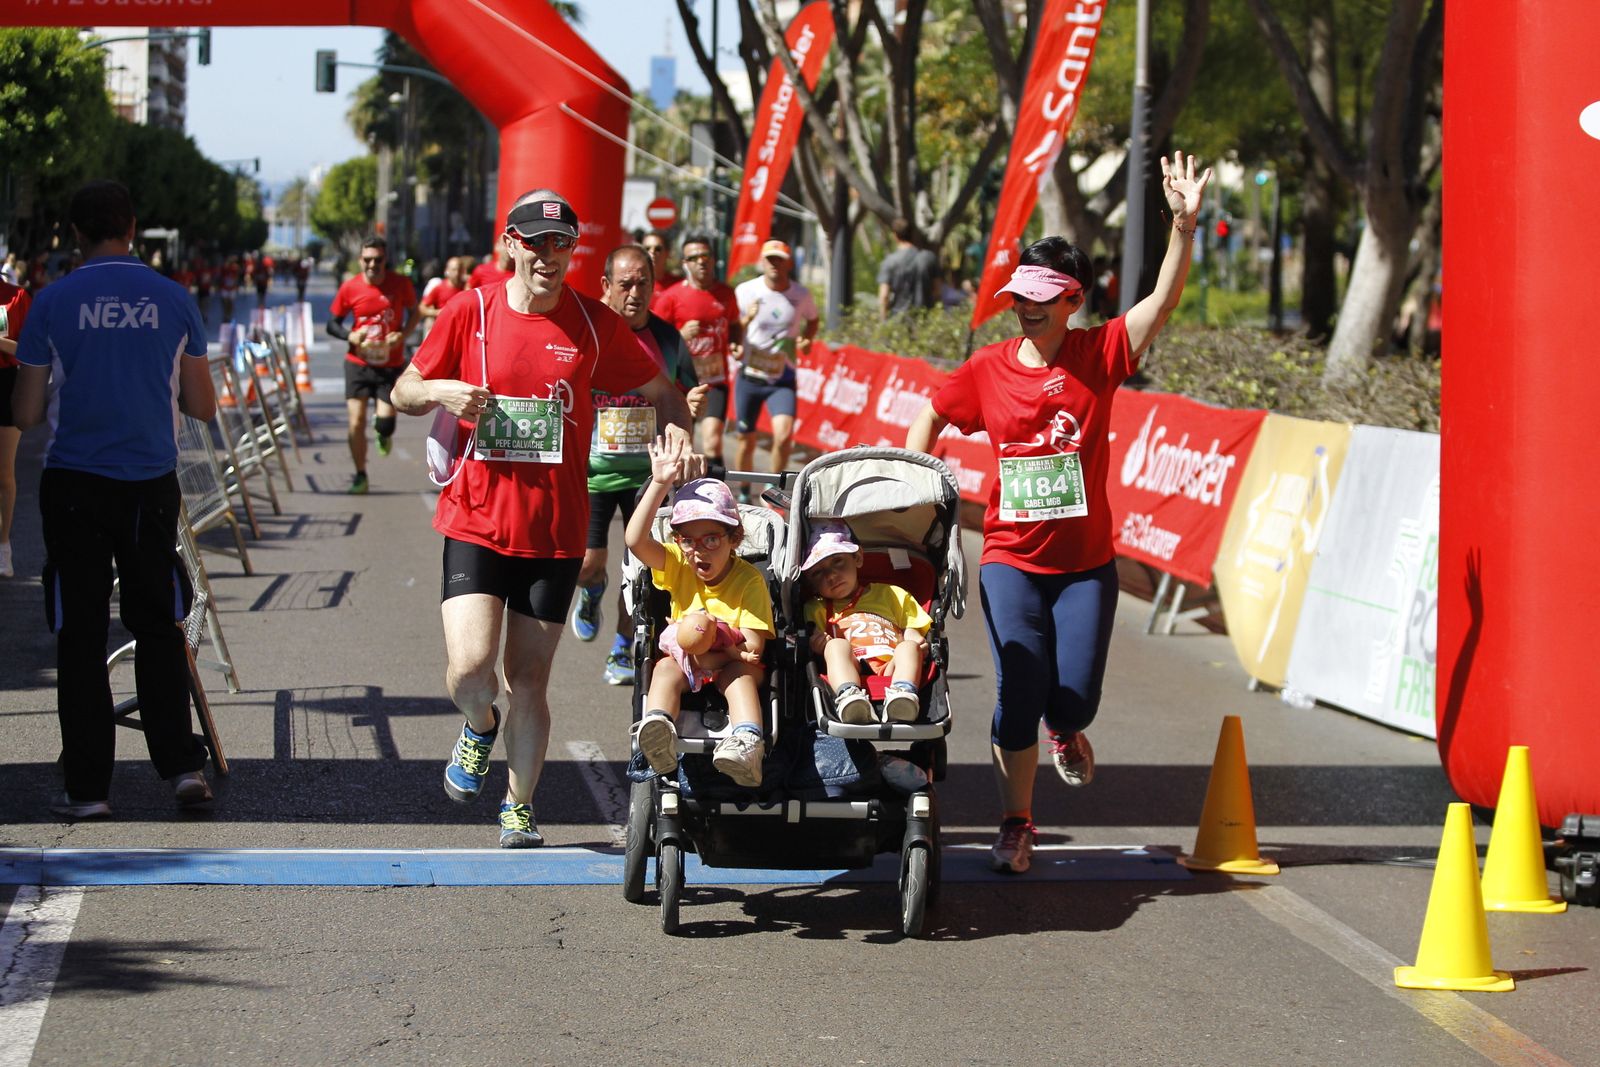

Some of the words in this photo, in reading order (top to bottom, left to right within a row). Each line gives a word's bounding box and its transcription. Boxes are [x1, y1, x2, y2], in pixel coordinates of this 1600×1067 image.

[1042, 0, 1104, 121] Sant
[485, 417, 548, 440] 1183
[605, 421, 648, 436] 3255
[495, 439, 511, 448] PEPE
[512, 440, 545, 450] CALVACHE
[1136, 424, 1237, 508] Santander
[1009, 474, 1069, 498] 1184
[1023, 499, 1046, 508] ISABEL
[1046, 497, 1061, 506] MGB
